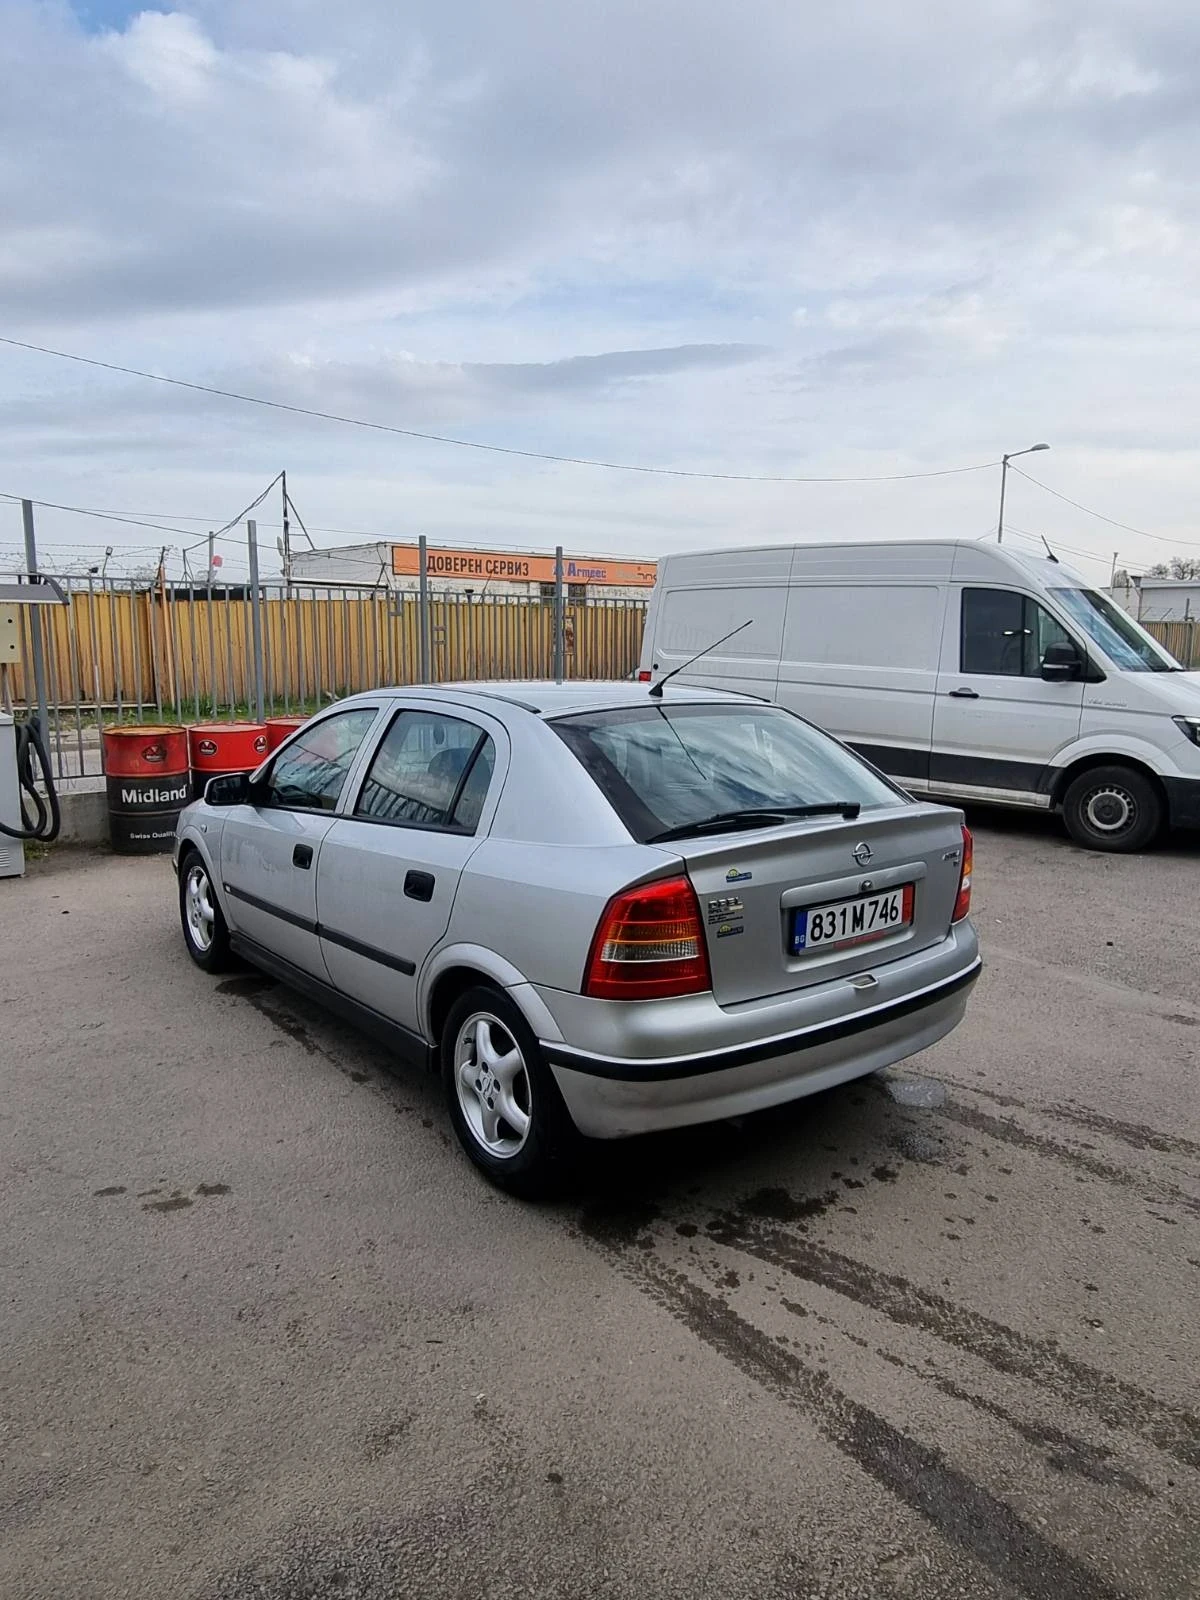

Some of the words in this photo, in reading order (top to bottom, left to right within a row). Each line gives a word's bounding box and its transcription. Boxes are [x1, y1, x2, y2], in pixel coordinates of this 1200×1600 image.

[427, 556, 482, 573] ДОВЕРЕН
[485, 559, 529, 576] СЕРВИЗ
[121, 785, 187, 803] Midland
[810, 895, 899, 942] 831M746
